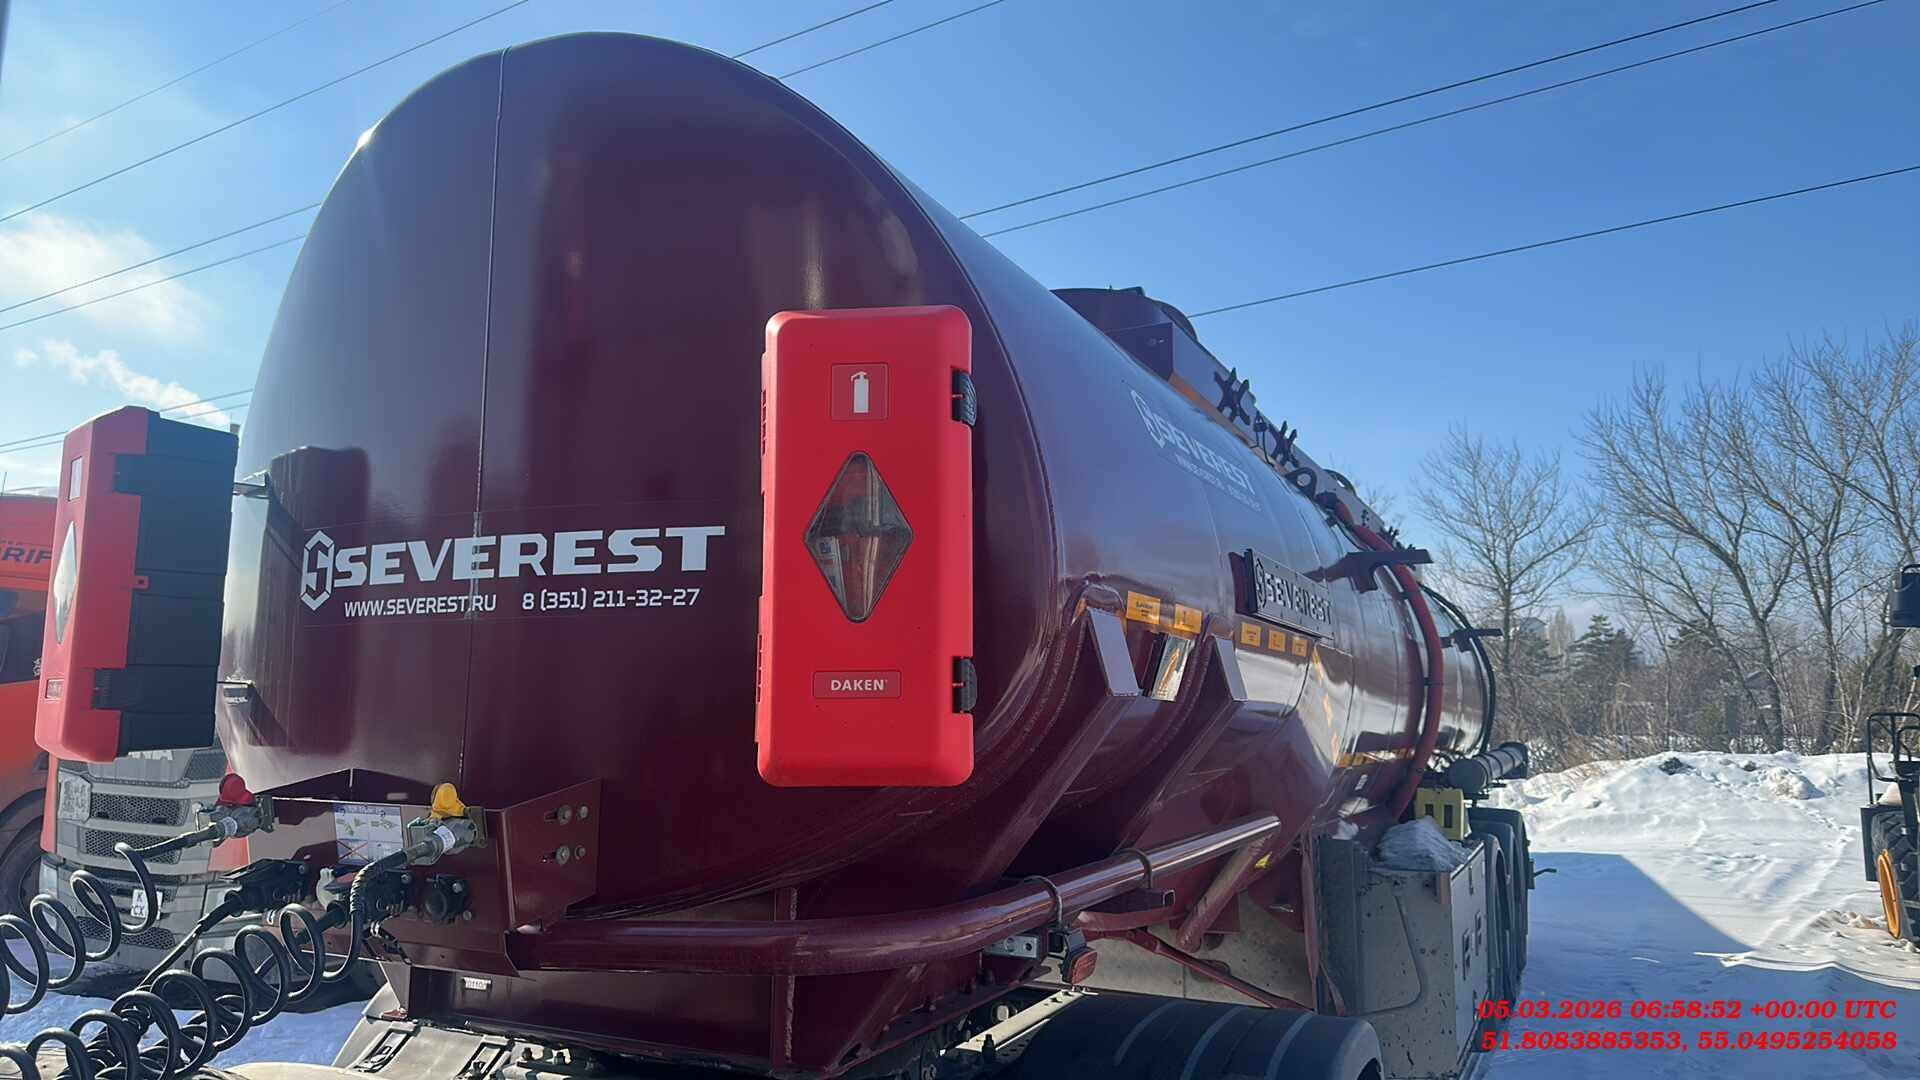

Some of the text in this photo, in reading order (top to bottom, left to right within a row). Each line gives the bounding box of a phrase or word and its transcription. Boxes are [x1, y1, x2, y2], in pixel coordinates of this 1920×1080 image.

[334, 526, 725, 588] SEVEREST
[344, 588, 701, 618] WWW.SEVEREST.RU 8 (351) 211-32-27
[831, 679, 885, 691] DAKEN
